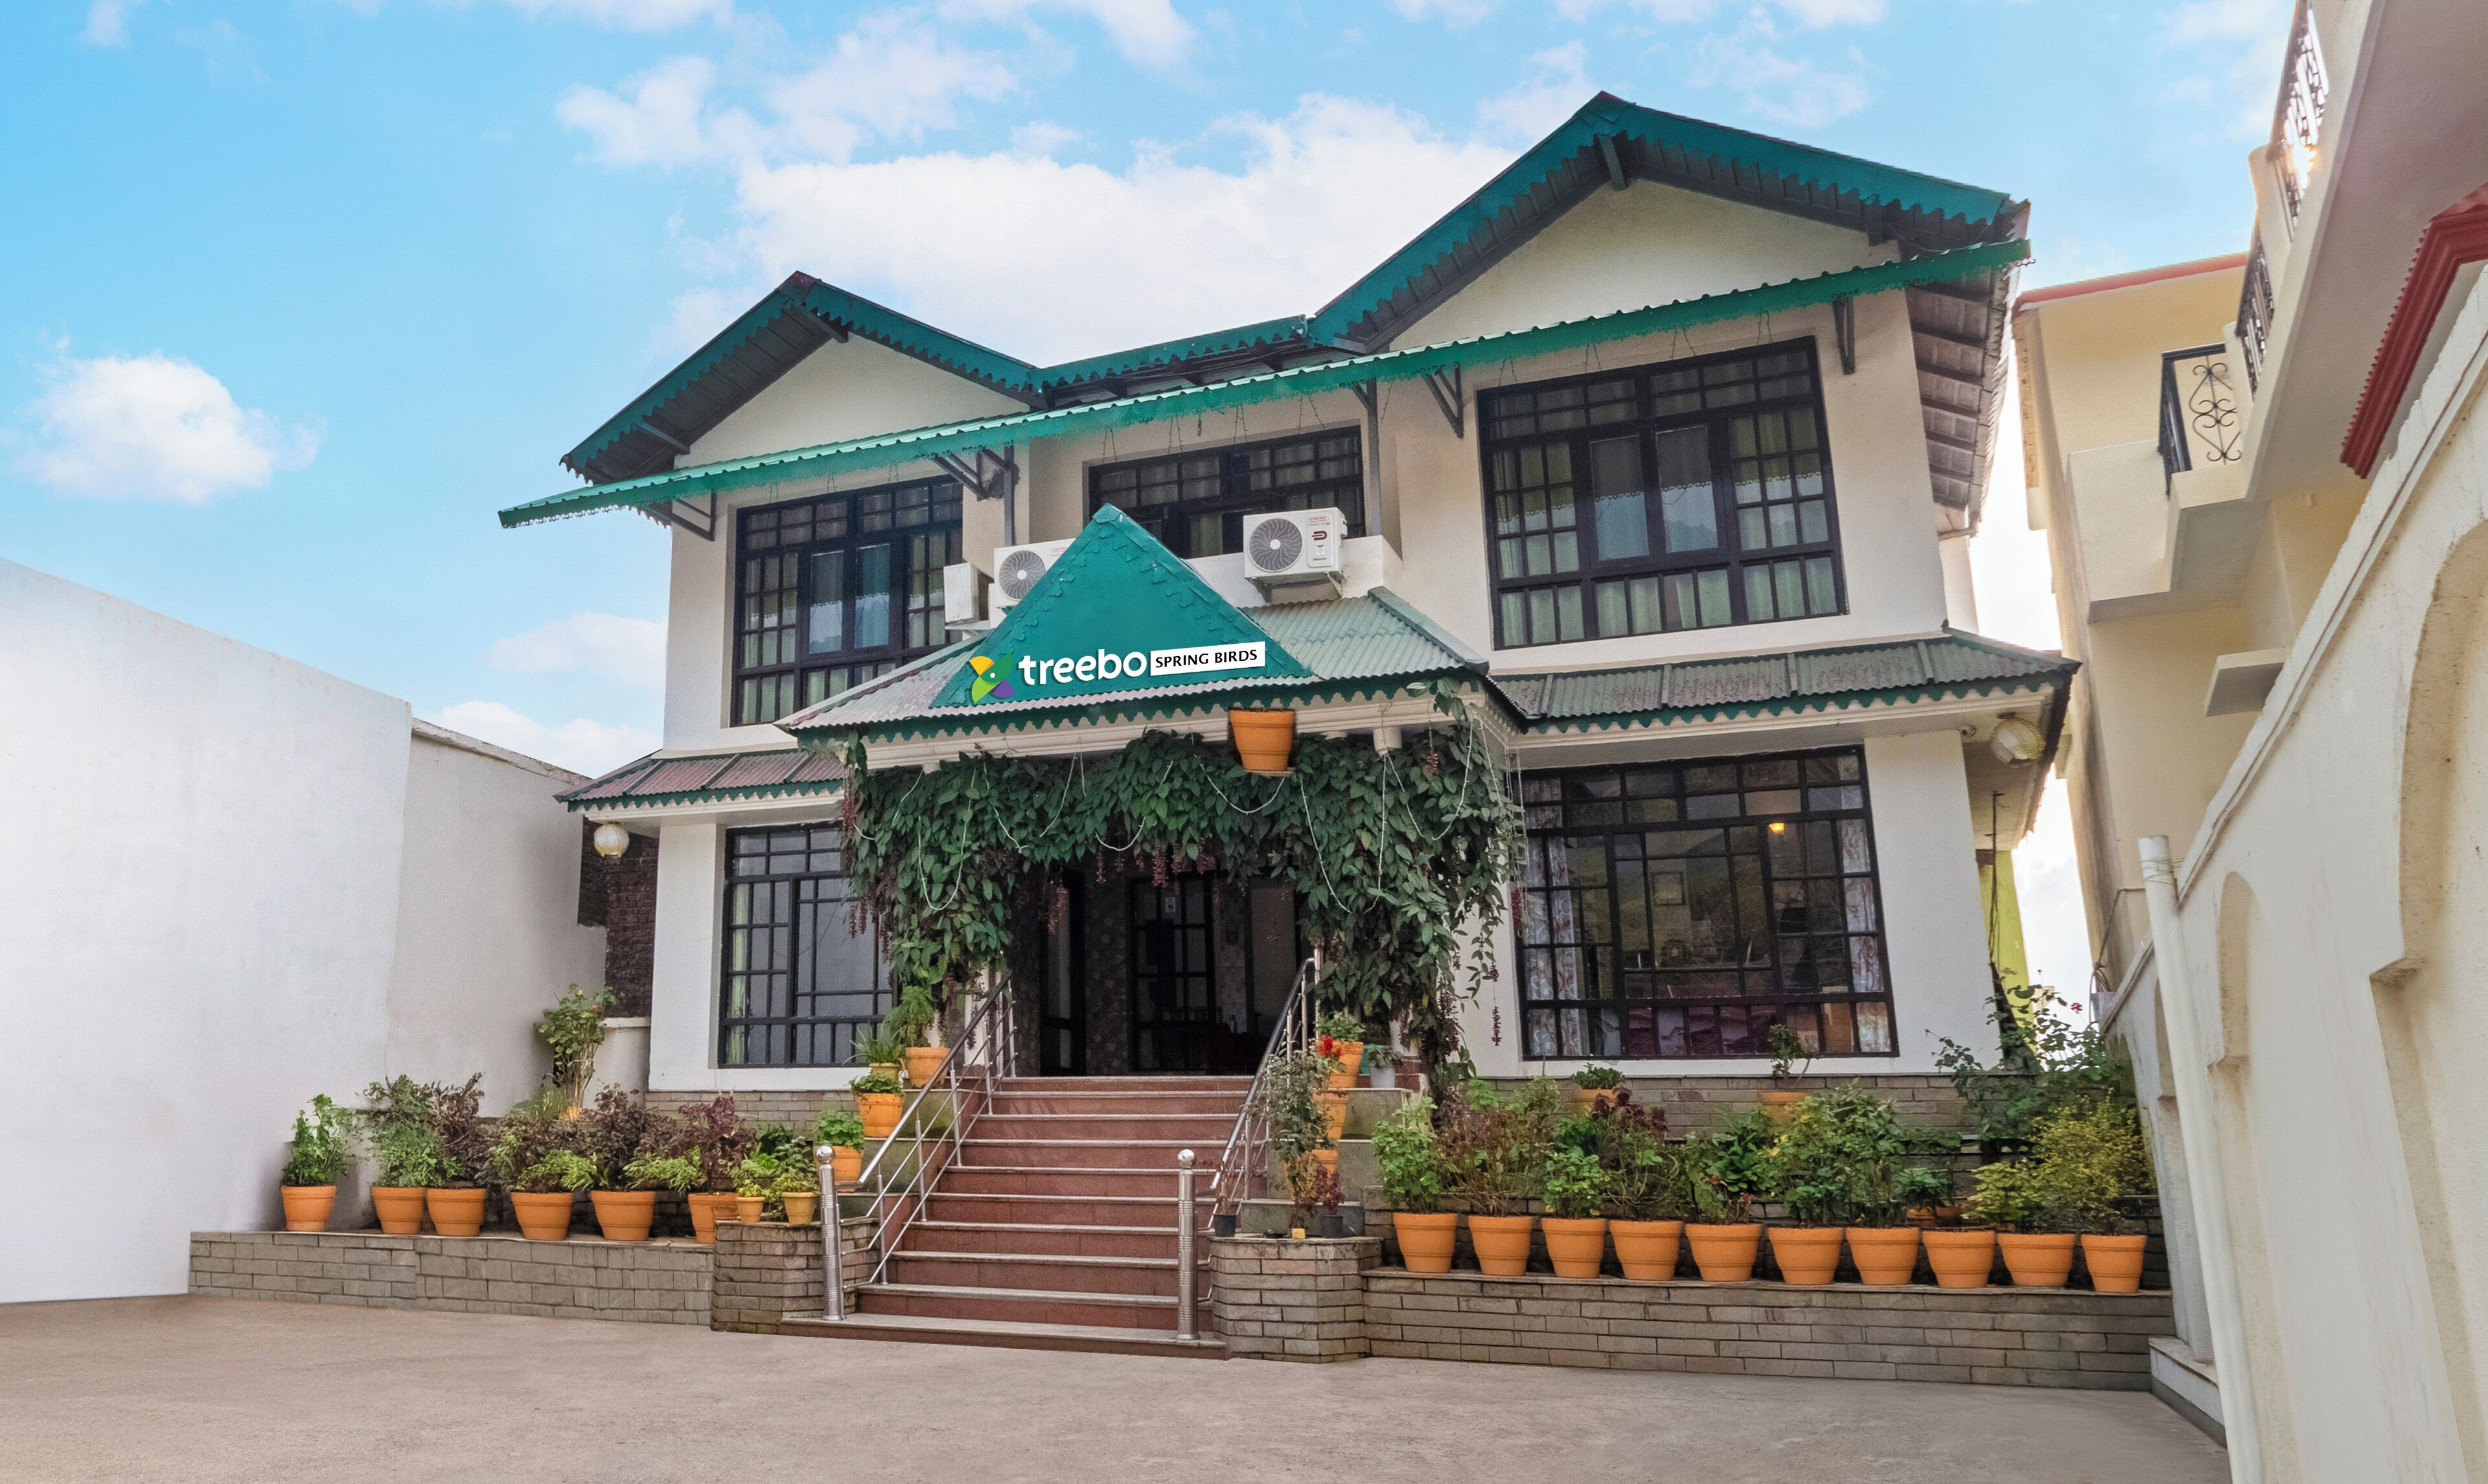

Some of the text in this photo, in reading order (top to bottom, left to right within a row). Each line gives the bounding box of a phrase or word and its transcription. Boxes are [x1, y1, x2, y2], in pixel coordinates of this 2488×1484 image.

[1019, 648, 1147, 685] treebo
[1155, 649, 1258, 668] SPRING BIRDS
